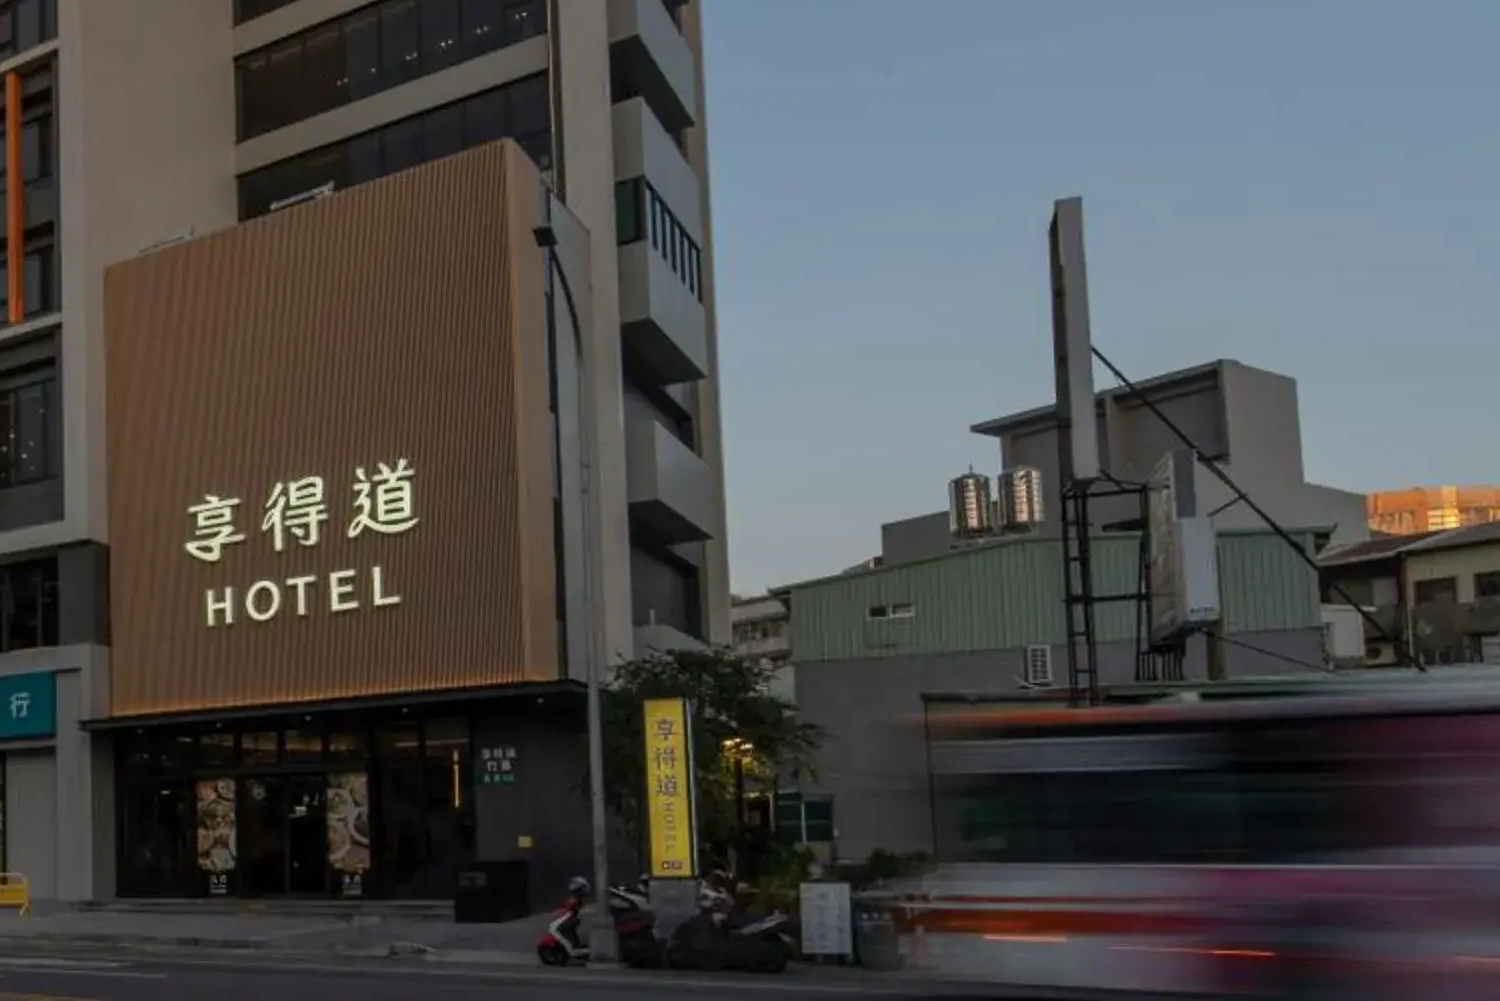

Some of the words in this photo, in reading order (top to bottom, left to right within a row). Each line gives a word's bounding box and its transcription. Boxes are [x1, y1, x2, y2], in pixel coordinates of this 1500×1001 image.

[184, 457, 420, 562] 享得道
[205, 565, 402, 627] HOTEL
